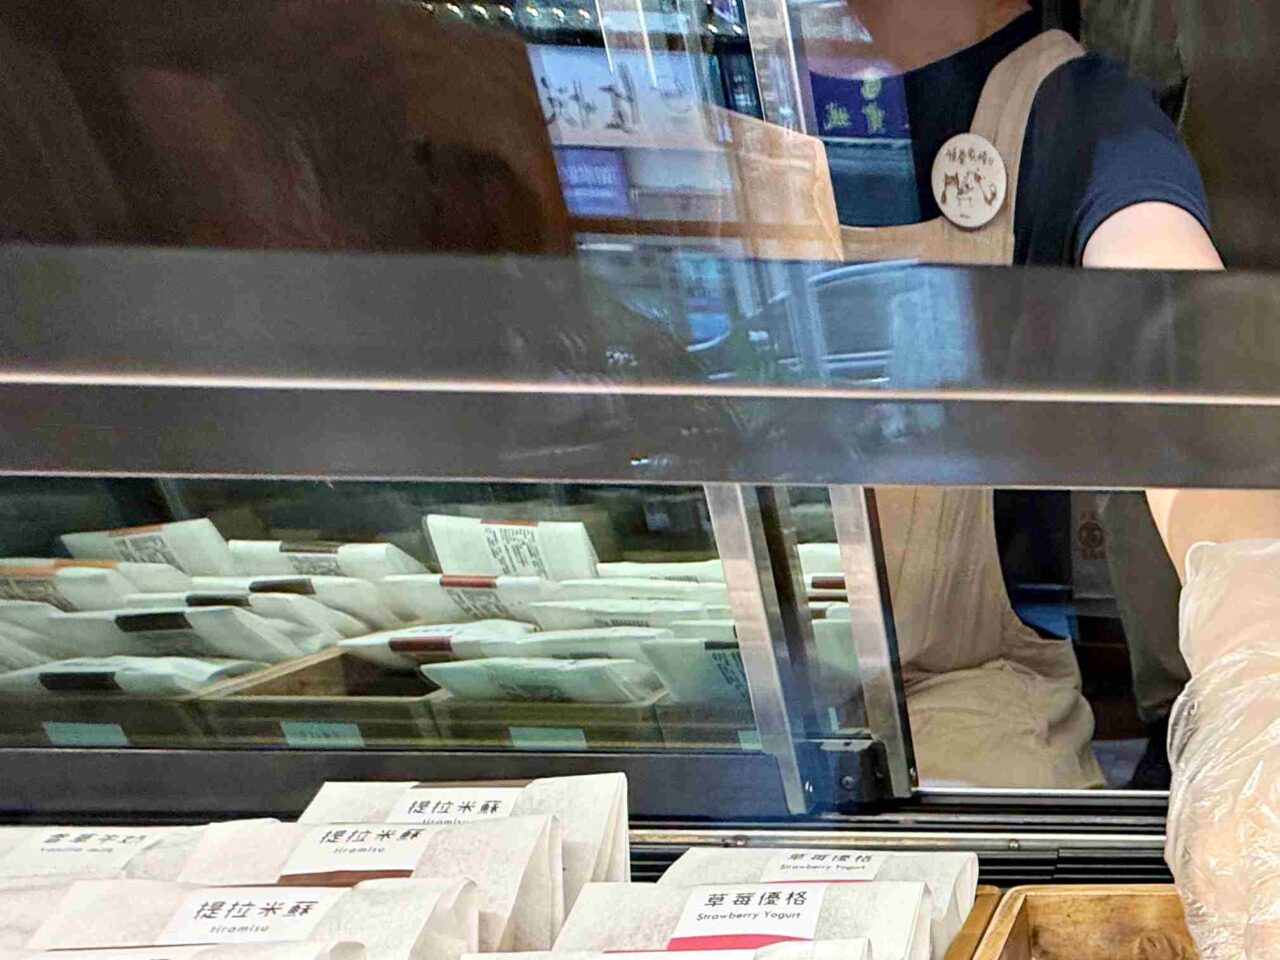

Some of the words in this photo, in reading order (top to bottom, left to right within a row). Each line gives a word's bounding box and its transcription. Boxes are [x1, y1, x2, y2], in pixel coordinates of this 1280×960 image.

[319, 828, 425, 844] 提拉米蘇
[704, 891, 808, 907] 草莓優格
[193, 901, 318, 920] 提拉米蘇
[696, 911, 760, 921] Strawberry
[764, 911, 802, 920] Yogurt
[210, 925, 270, 933] tiramisu
